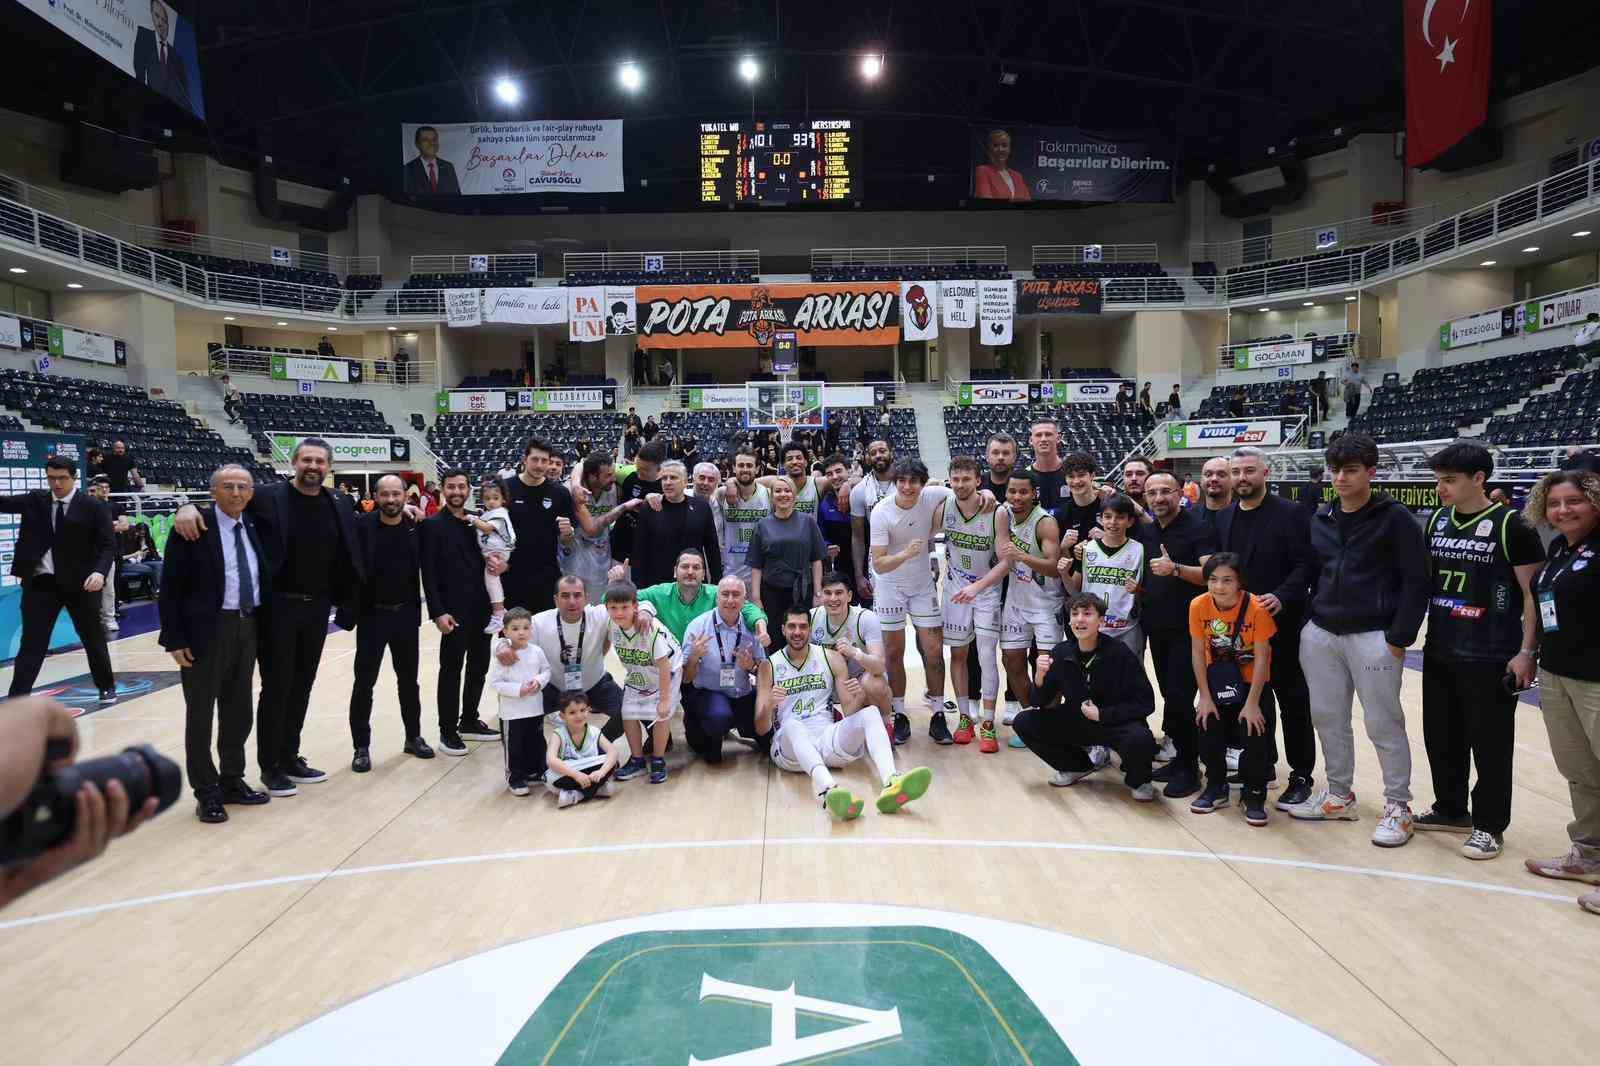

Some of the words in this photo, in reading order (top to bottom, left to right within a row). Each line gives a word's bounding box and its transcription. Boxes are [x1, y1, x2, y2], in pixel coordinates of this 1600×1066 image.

[1038, 156, 1107, 170] Başarılar
[1110, 157, 1169, 170] Dilerim.
[943, 287, 976, 297] WELCOME
[956, 299, 963, 308] TO
[793, 292, 893, 330] ARKASI
[951, 312, 967, 321] HELL
[643, 300, 730, 335] POTA
[1255, 350, 1305, 362] GOCAMAN
[1278, 367, 1290, 377] B5
[1042, 386, 1053, 395] B4
[520, 394, 530, 403] B2
[1431, 549, 1494, 564] erkezefendi
[1438, 569, 1468, 593] 77
[1217, 690, 1236, 699] PUMA
[792, 698, 816, 716] 44
